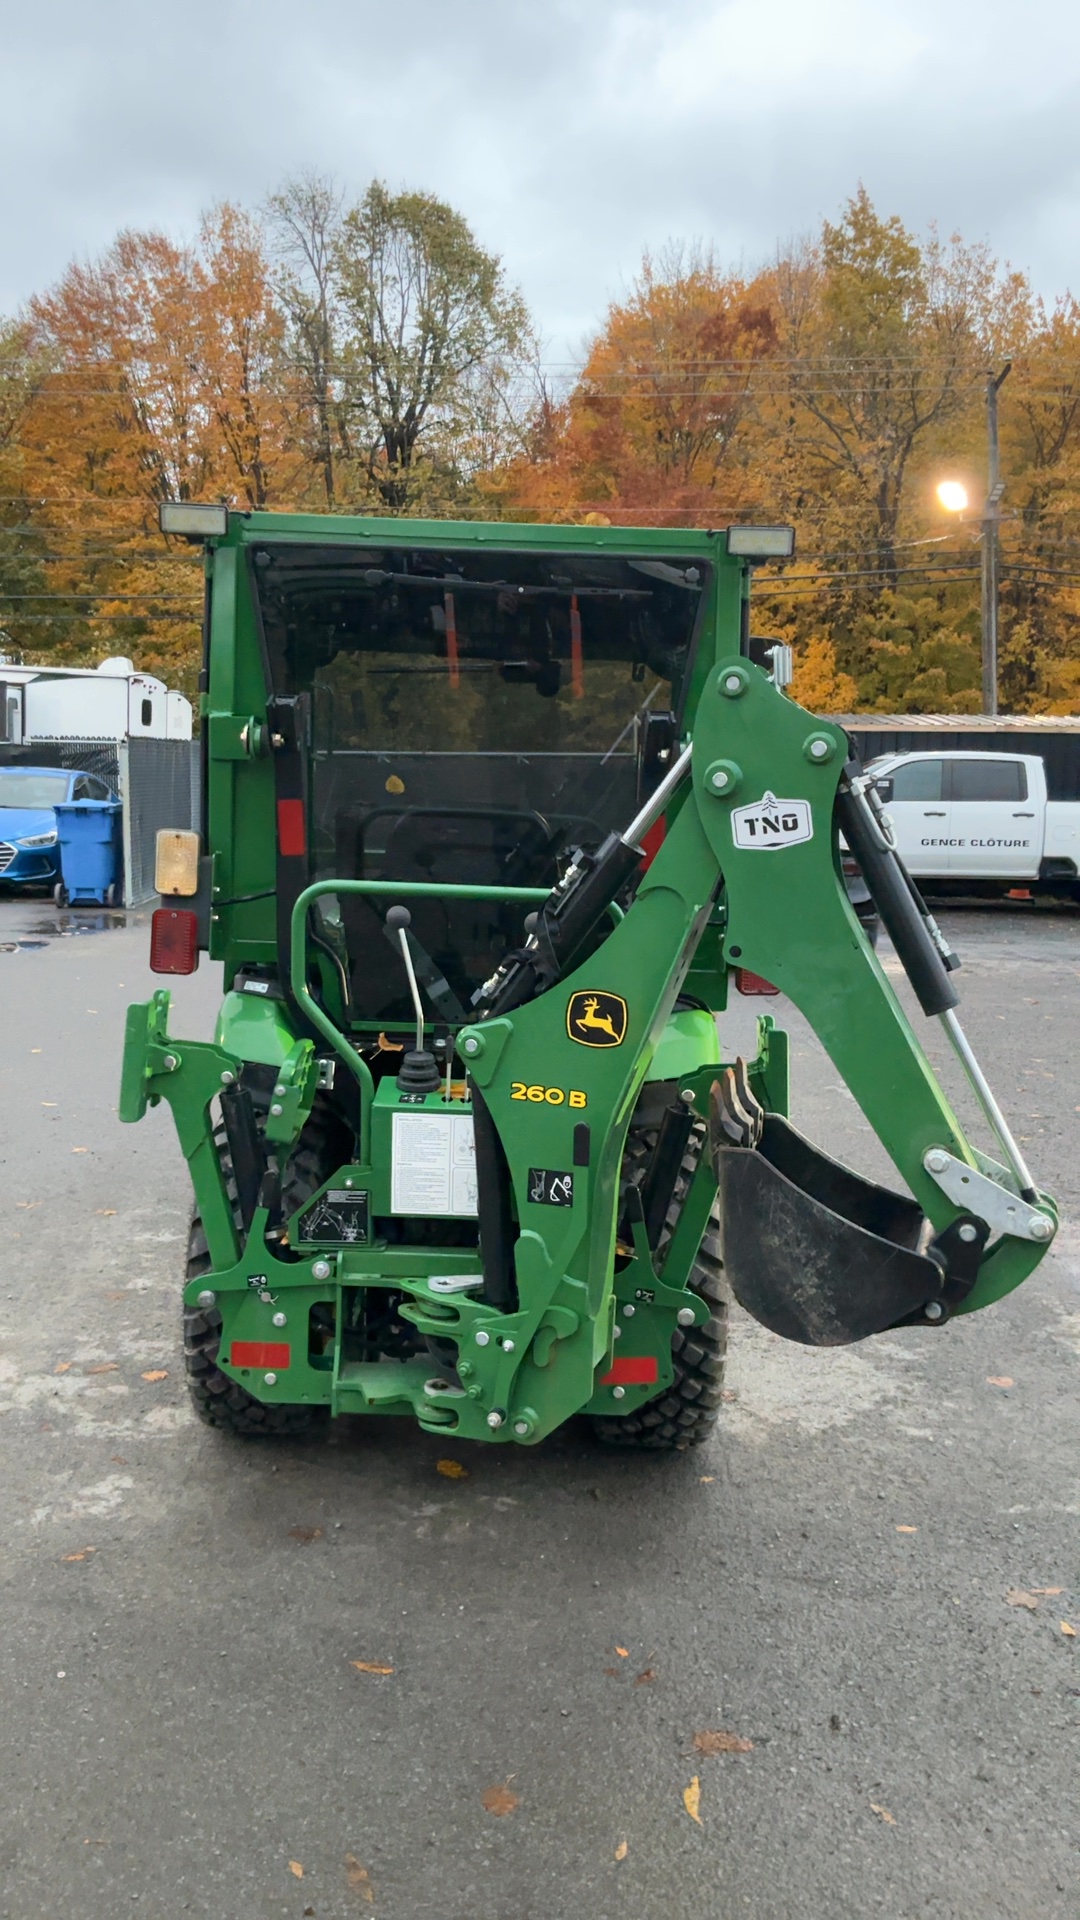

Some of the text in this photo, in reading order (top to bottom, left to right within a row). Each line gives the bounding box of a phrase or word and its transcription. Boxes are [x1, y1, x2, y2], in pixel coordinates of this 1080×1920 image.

[744, 813, 798, 836] TNO
[921, 838, 1030, 848] GENCE CLÔTURE
[510, 1082, 587, 1109] 260 B
